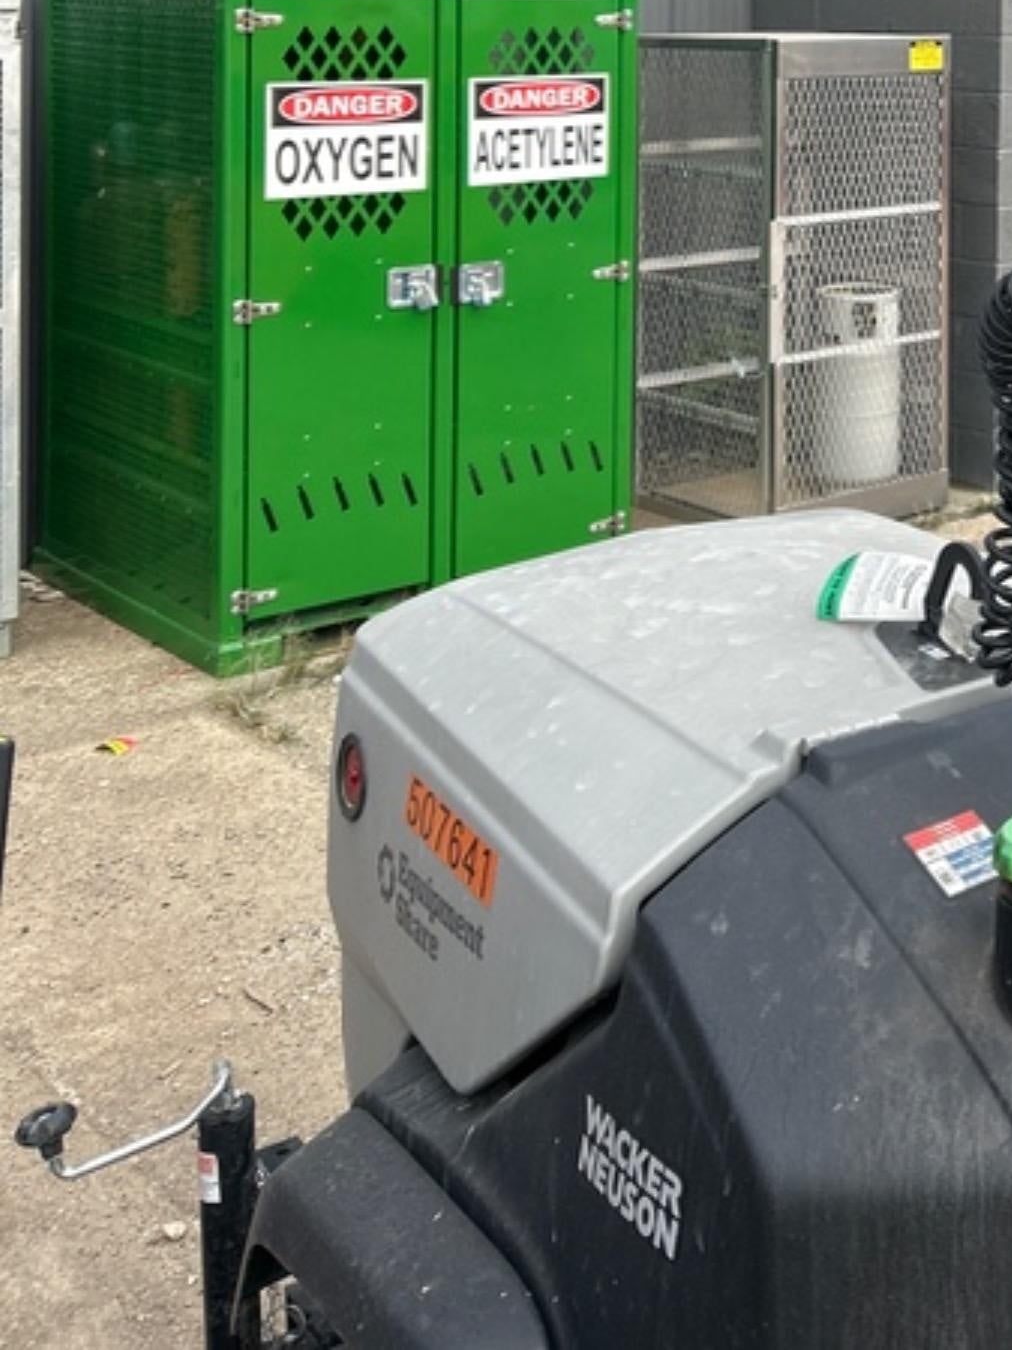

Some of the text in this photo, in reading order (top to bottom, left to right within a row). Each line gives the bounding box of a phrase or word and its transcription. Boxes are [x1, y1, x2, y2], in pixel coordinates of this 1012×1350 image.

[292, 92, 405, 119] DANGER
[489, 85, 591, 111] DANGER
[274, 133, 420, 186] OXYGEN
[473, 123, 604, 173] ACETYLENE
[406, 776, 493, 900] 507641
[398, 851, 484, 962] Equipment
[577, 1133, 680, 1261] NEUSON
[586, 1093, 683, 1219] WACKER
